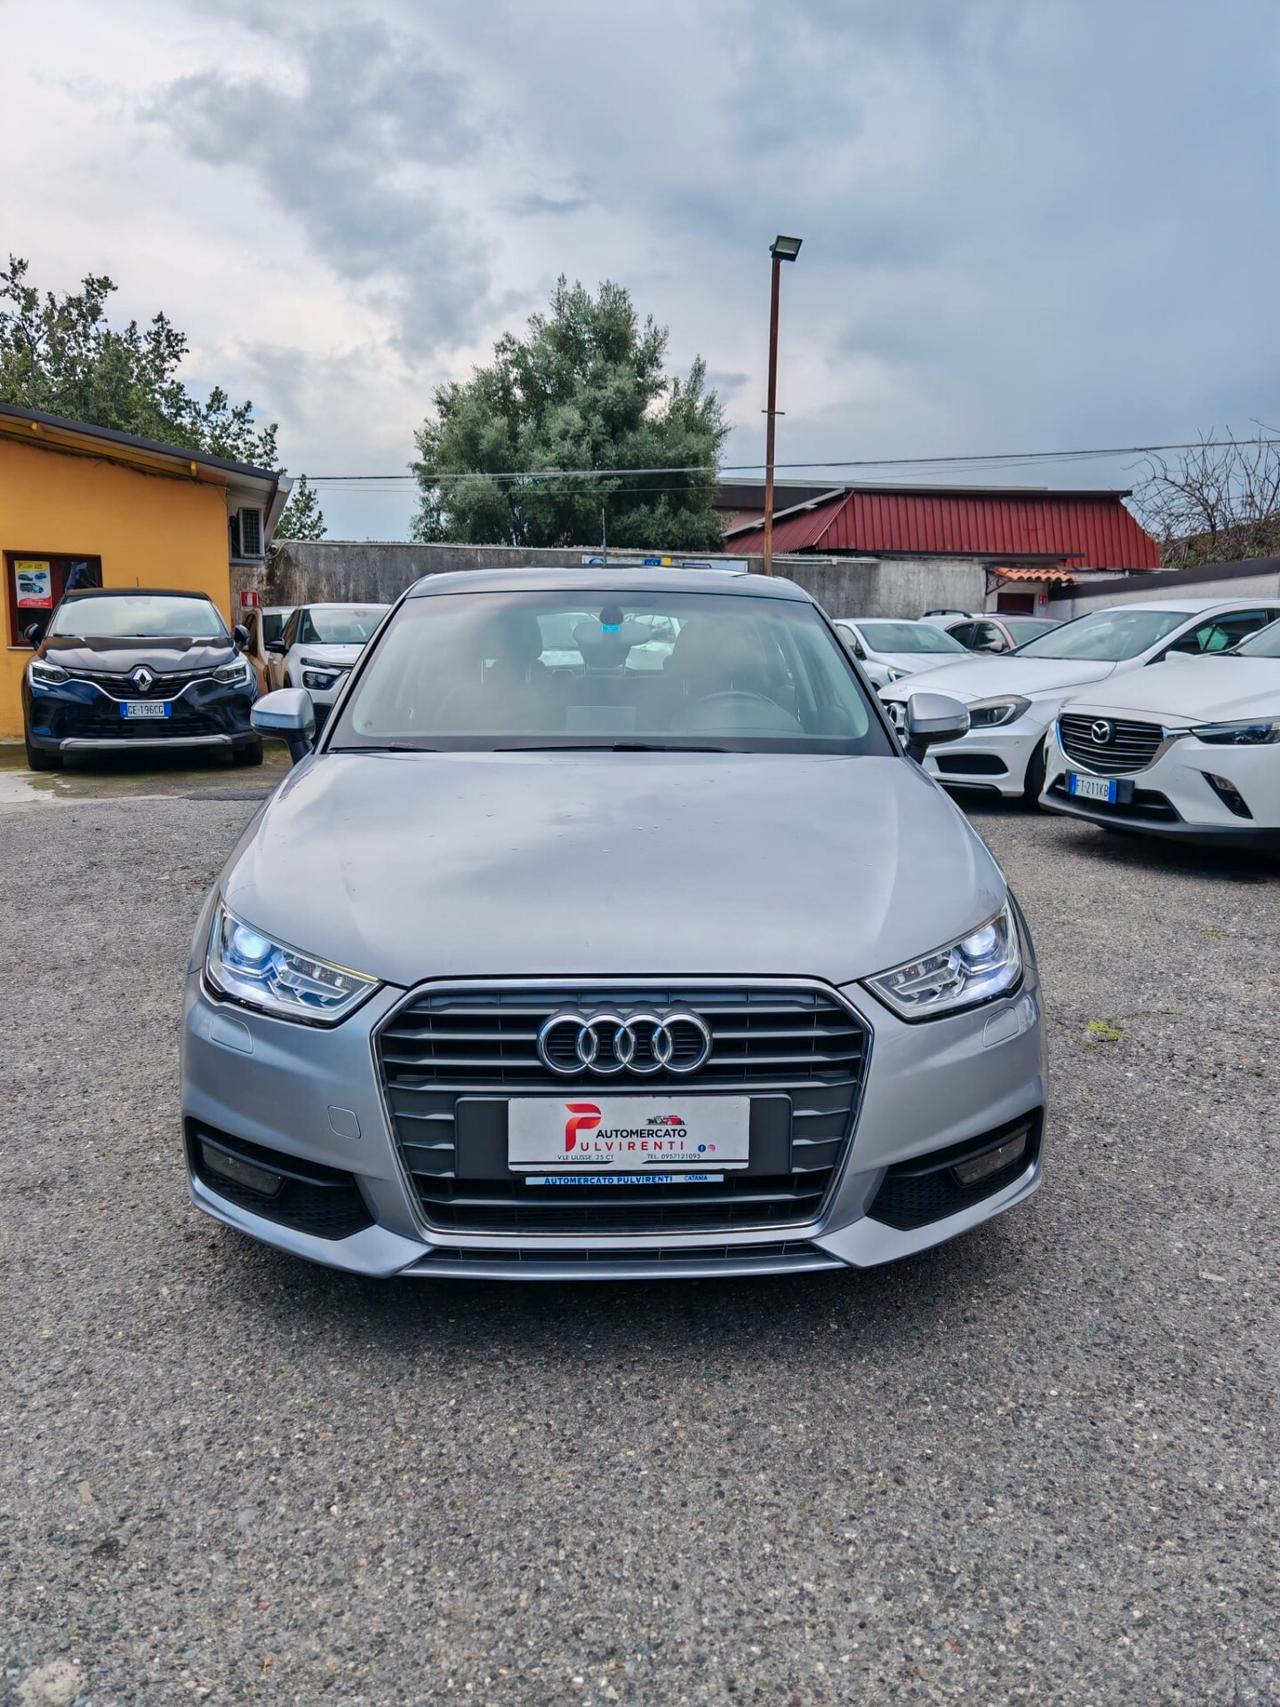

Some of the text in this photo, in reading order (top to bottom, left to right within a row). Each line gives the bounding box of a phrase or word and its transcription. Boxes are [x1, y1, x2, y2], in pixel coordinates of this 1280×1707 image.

[596, 1128, 687, 1139] AUTOMERCATO
[544, 1177, 614, 1185] AUTOMERCATO
[617, 1175, 673, 1184] PULVIRENTI
